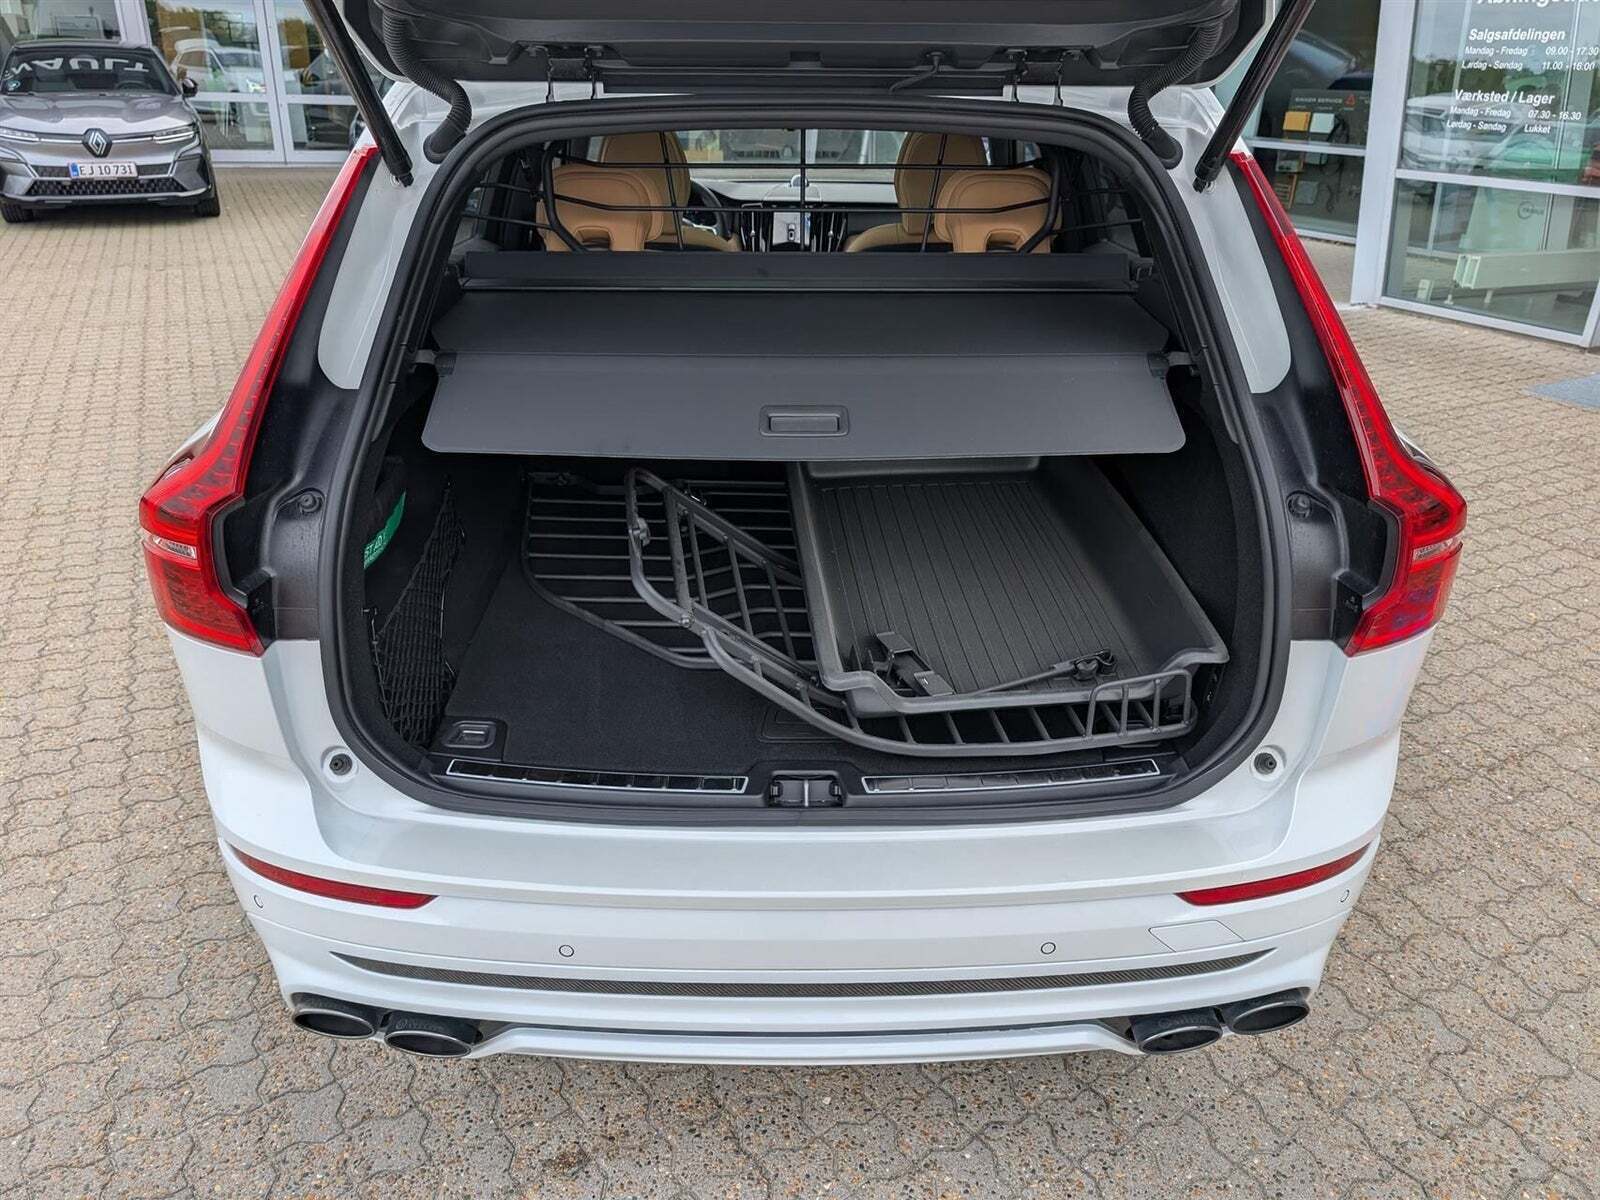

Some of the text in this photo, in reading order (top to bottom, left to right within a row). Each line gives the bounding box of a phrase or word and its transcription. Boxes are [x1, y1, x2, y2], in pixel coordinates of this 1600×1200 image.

[1469, 28, 1566, 43] Salgsafdelingen
[1465, 46, 1495, 56] Mandag
[1500, 46, 1528, 57] Fredag
[1545, 46, 1568, 56] 09.00
[1576, 47, 1599, 56] 17.30
[1542, 61, 1563, 70] 11.00
[1455, 89, 1510, 103] Værksted
[1519, 91, 1555, 106] Lager
[1450, 106, 1479, 116] Mandag
[1484, 107, 1512, 119] Fredag
[1528, 109, 1551, 119] 07.30
[1524, 123, 1551, 134] Lukket
[79, 165, 94, 176] EJ
